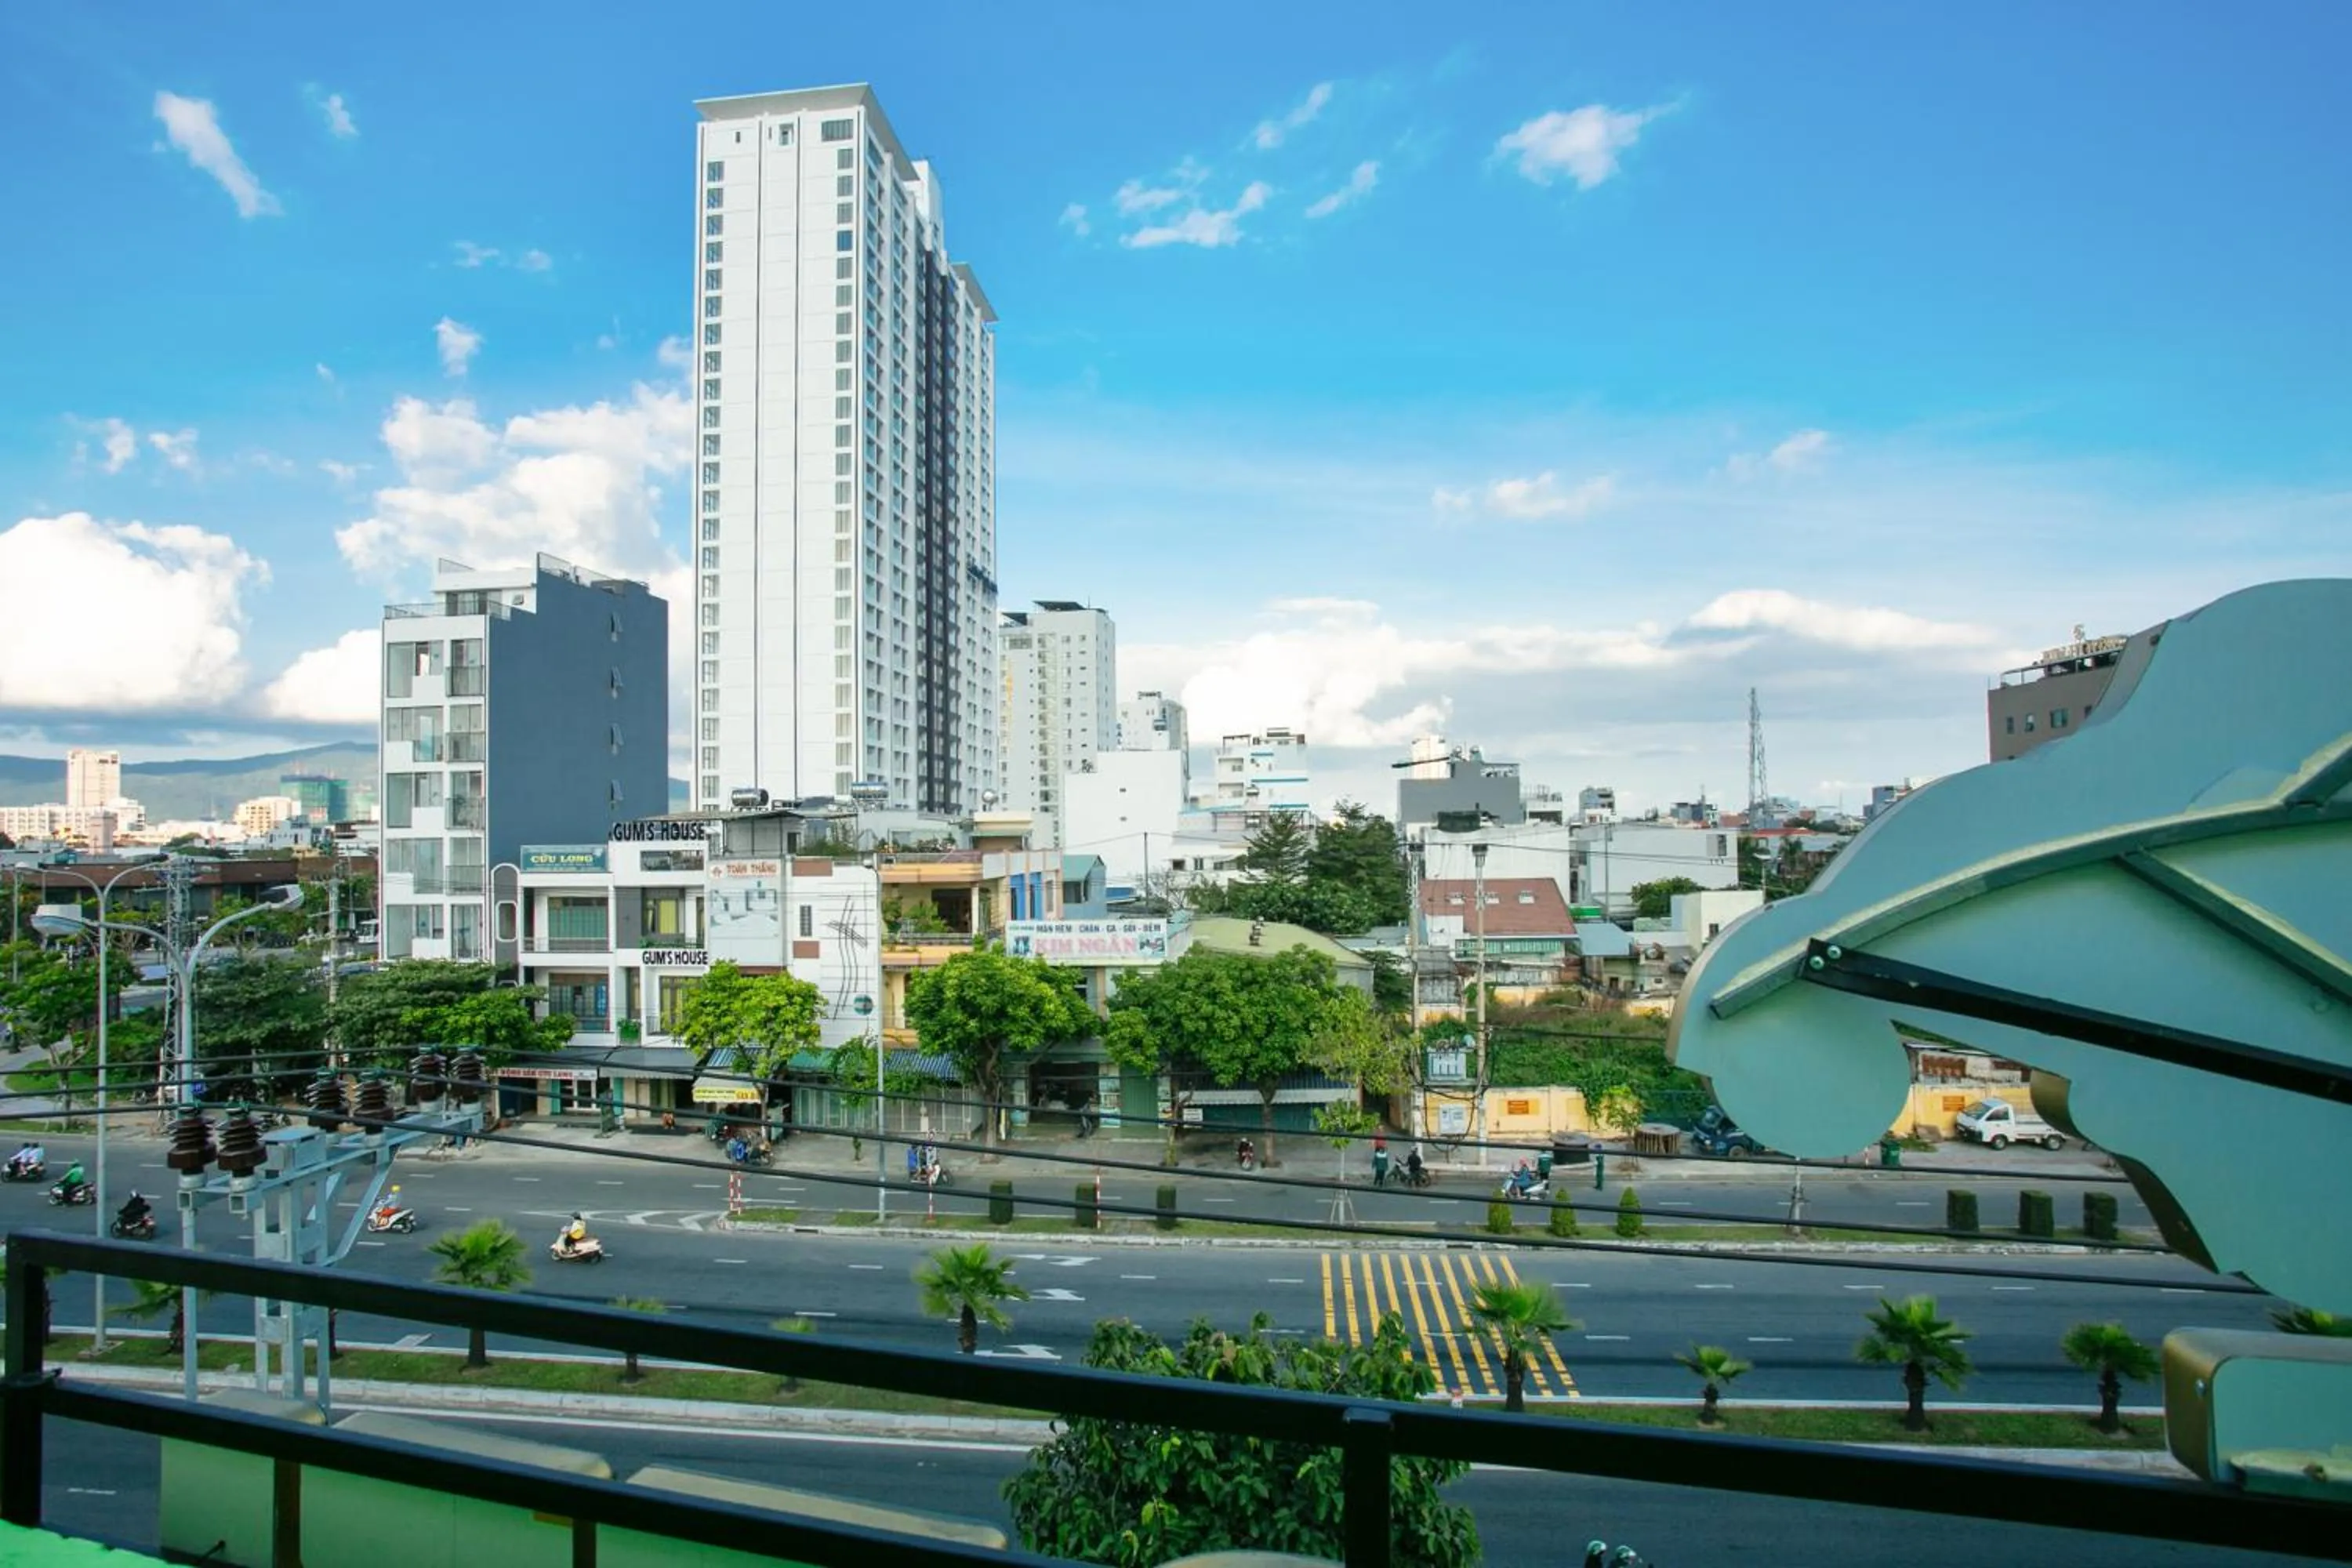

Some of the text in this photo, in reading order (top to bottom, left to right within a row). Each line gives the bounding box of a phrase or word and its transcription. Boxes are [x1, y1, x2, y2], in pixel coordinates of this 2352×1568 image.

[661, 821, 705, 841] HOUSE
[1035, 938, 1073, 953] KIM
[674, 950, 708, 965] HOUSE
